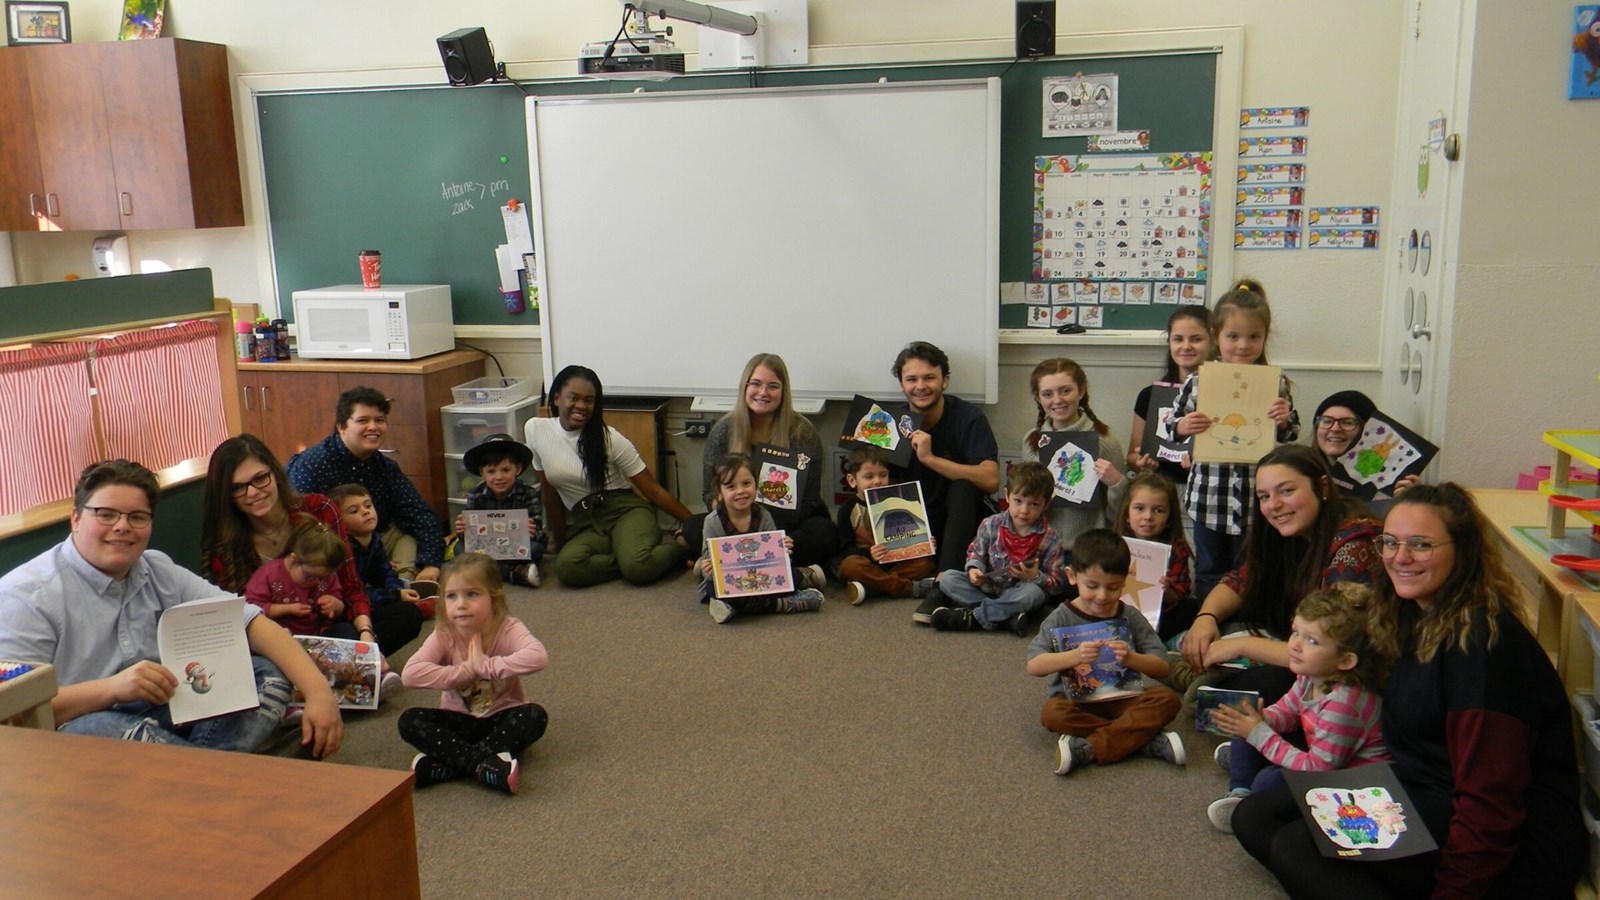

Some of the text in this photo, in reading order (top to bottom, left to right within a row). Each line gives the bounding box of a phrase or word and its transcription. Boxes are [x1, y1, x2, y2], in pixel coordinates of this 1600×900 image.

[1256, 172, 1273, 180] Zack
[441, 181, 477, 201] Antoine
[1254, 193, 1274, 203] Zoé
[1159, 450, 1180, 459] Merci
[886, 531, 917, 542] CAMPING
